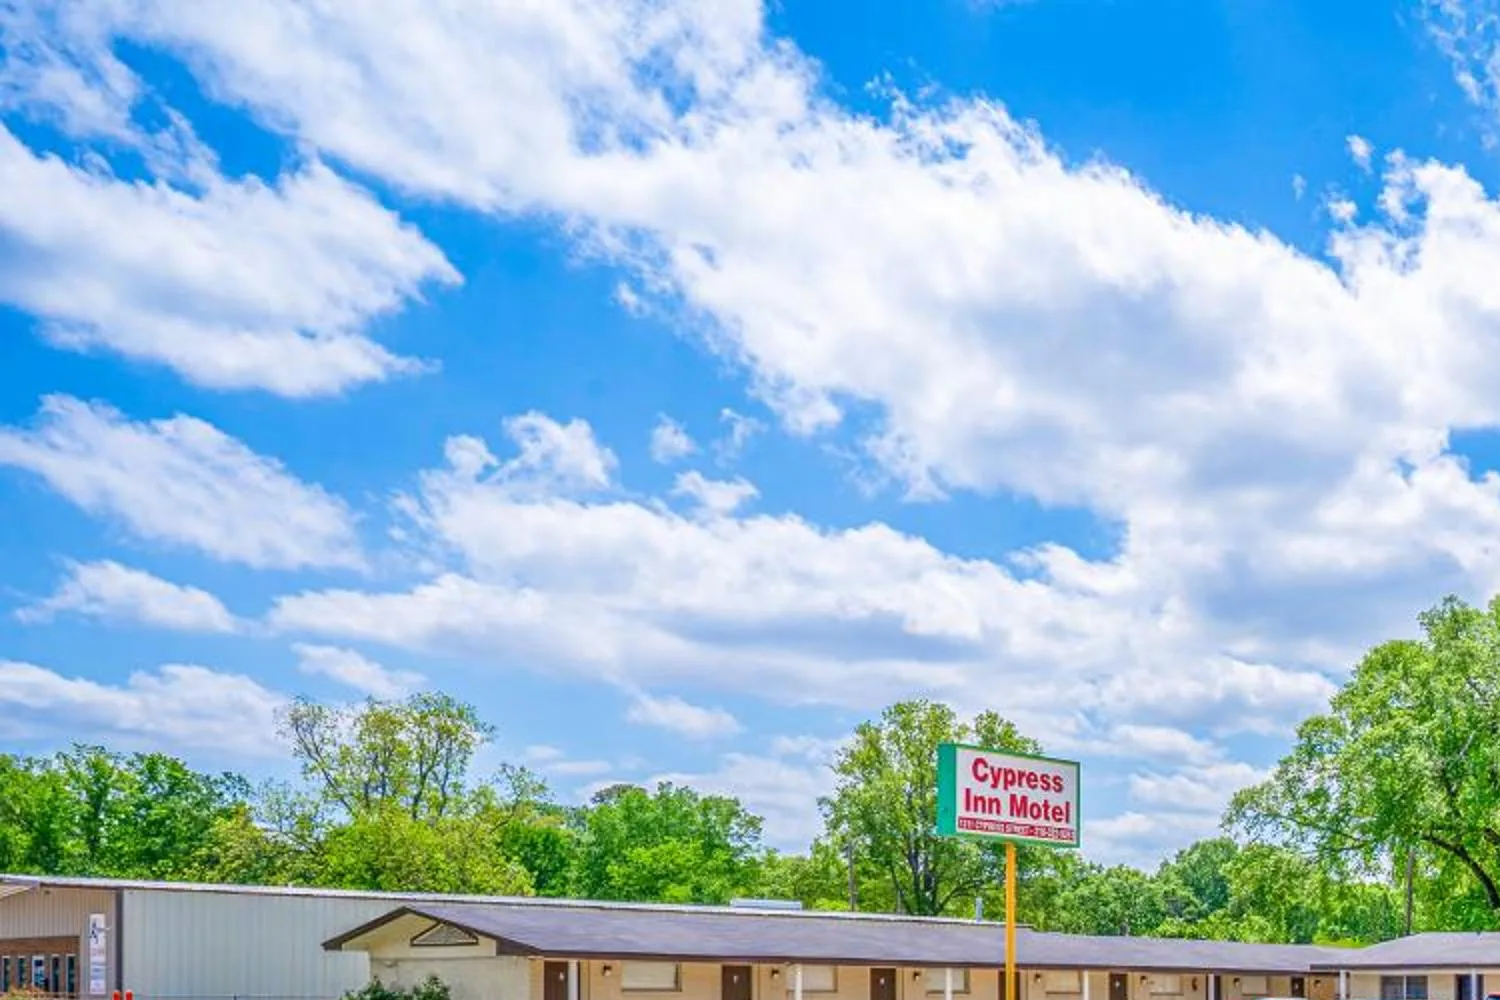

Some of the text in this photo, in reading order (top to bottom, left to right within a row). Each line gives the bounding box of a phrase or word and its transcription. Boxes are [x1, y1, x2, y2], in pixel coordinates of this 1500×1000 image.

[971, 757, 1064, 793] Cypress
[964, 787, 1070, 824] Inn Motel
